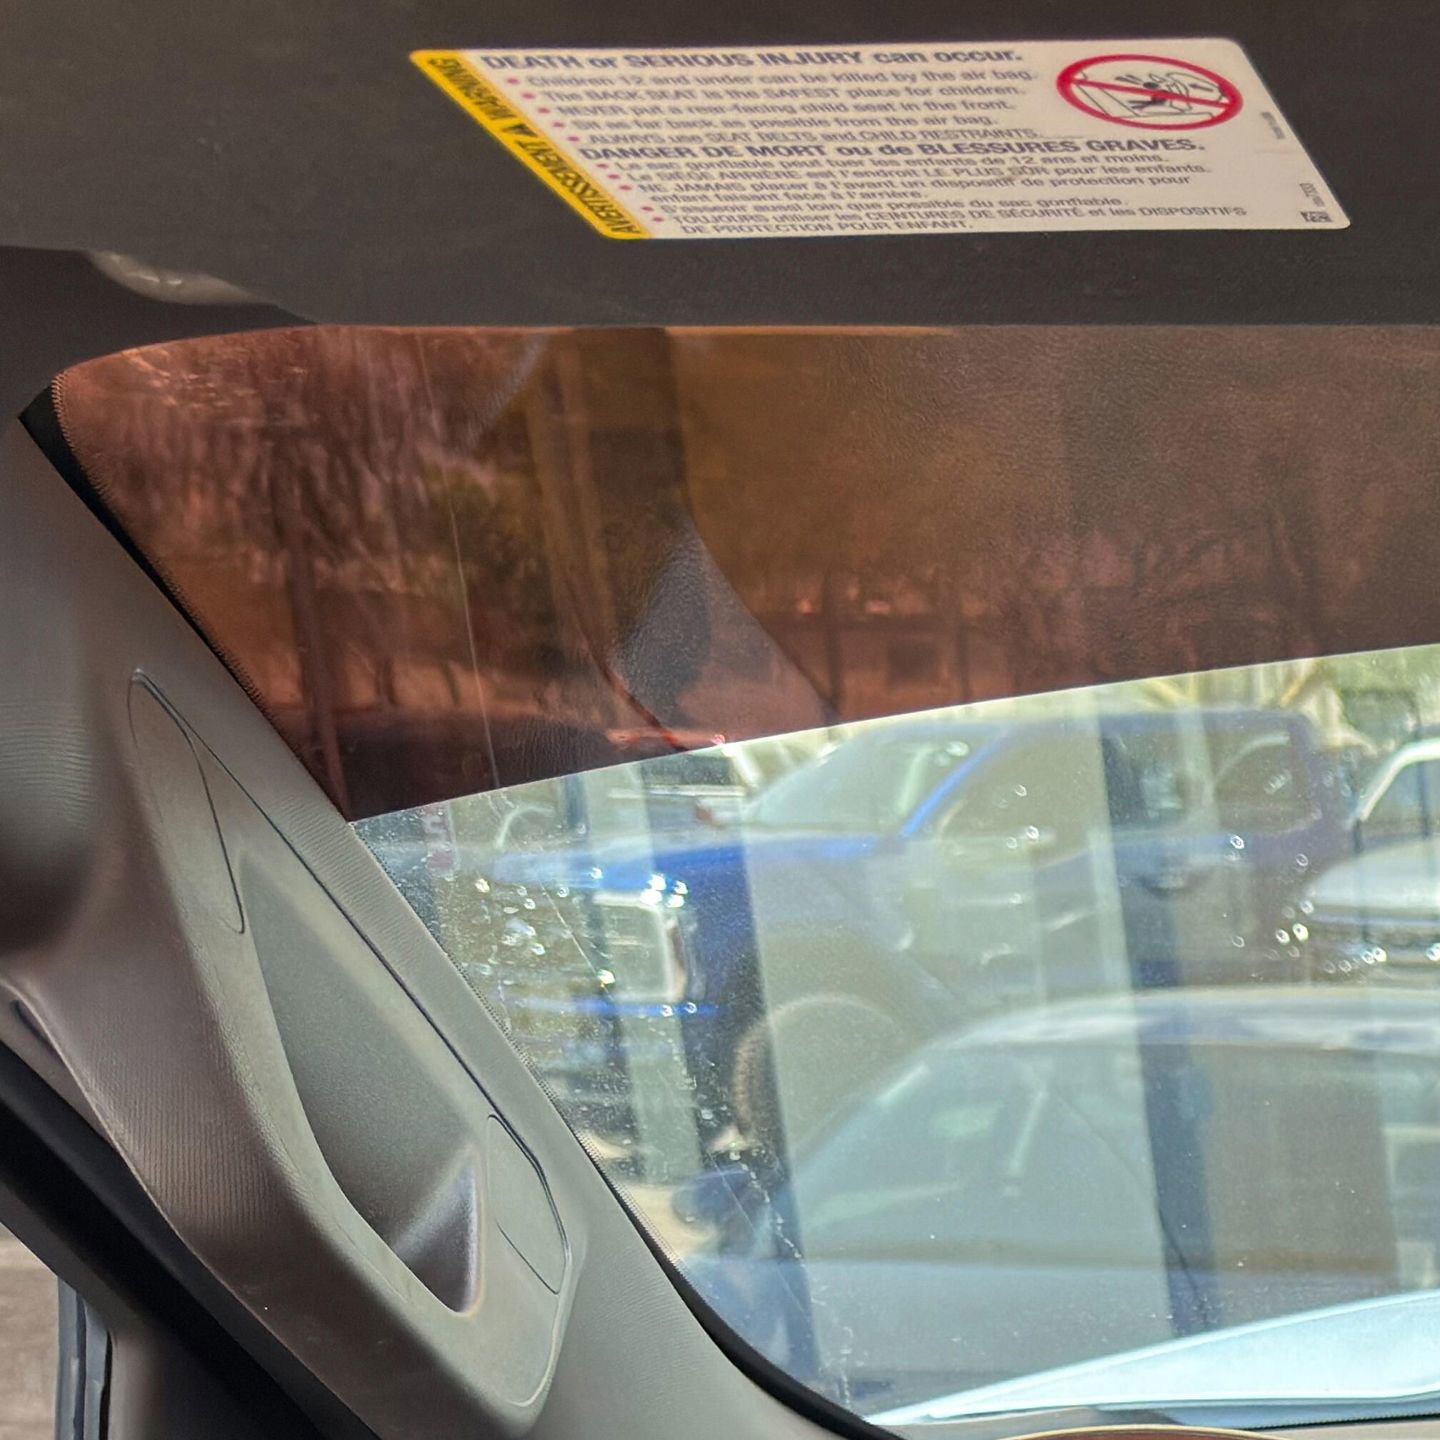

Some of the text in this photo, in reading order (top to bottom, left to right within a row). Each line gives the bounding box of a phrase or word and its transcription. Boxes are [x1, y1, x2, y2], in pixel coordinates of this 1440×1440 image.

[481, 49, 1022, 69] DEATH or SERIOUS INJURY can occur.
[528, 69, 1038, 87] Children 12 and under can be killed by the air bag.
[543, 86, 1025, 102] The BACK SEAT is the SAFEST place for children.
[557, 99, 1017, 118] NEVER put a rear-facing child seat in the front.
[579, 138, 1204, 160] DANGER DE MORT ou de BLESSURES GRAVES.
